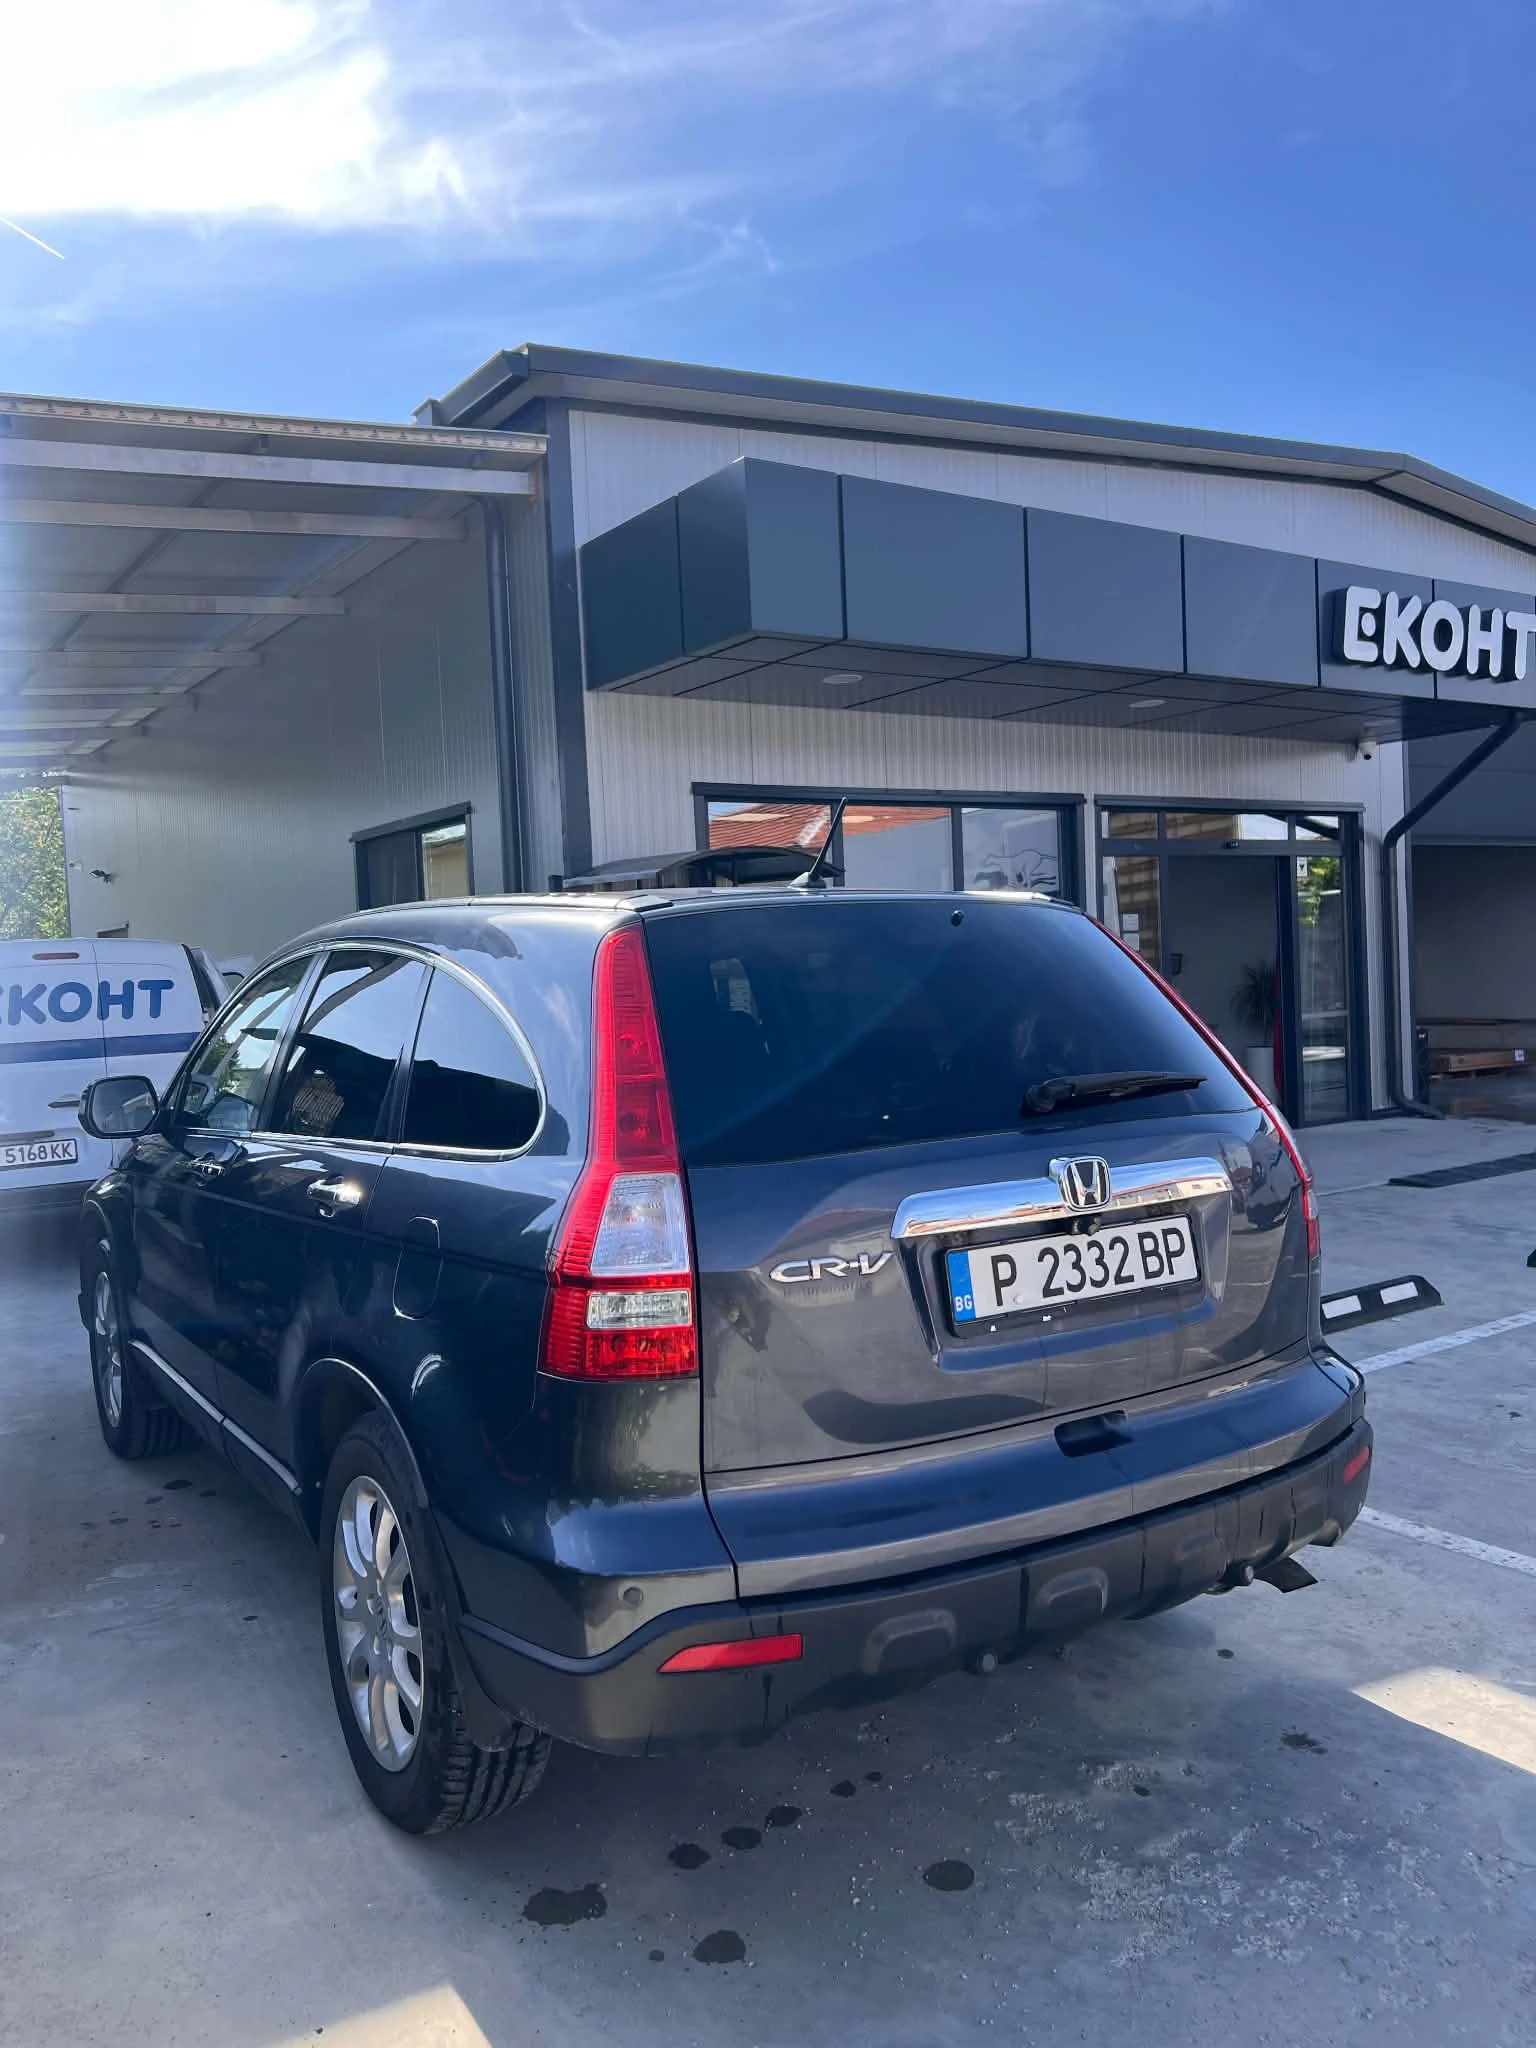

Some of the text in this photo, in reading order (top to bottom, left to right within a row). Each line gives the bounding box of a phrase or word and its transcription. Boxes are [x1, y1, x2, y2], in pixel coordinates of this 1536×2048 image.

[1344, 585, 1536, 680] ЕКОНТ
[0, 979, 175, 1026] КОНТ
[769, 1250, 895, 1284] CR-V
[955, 1296, 973, 1312] BG
